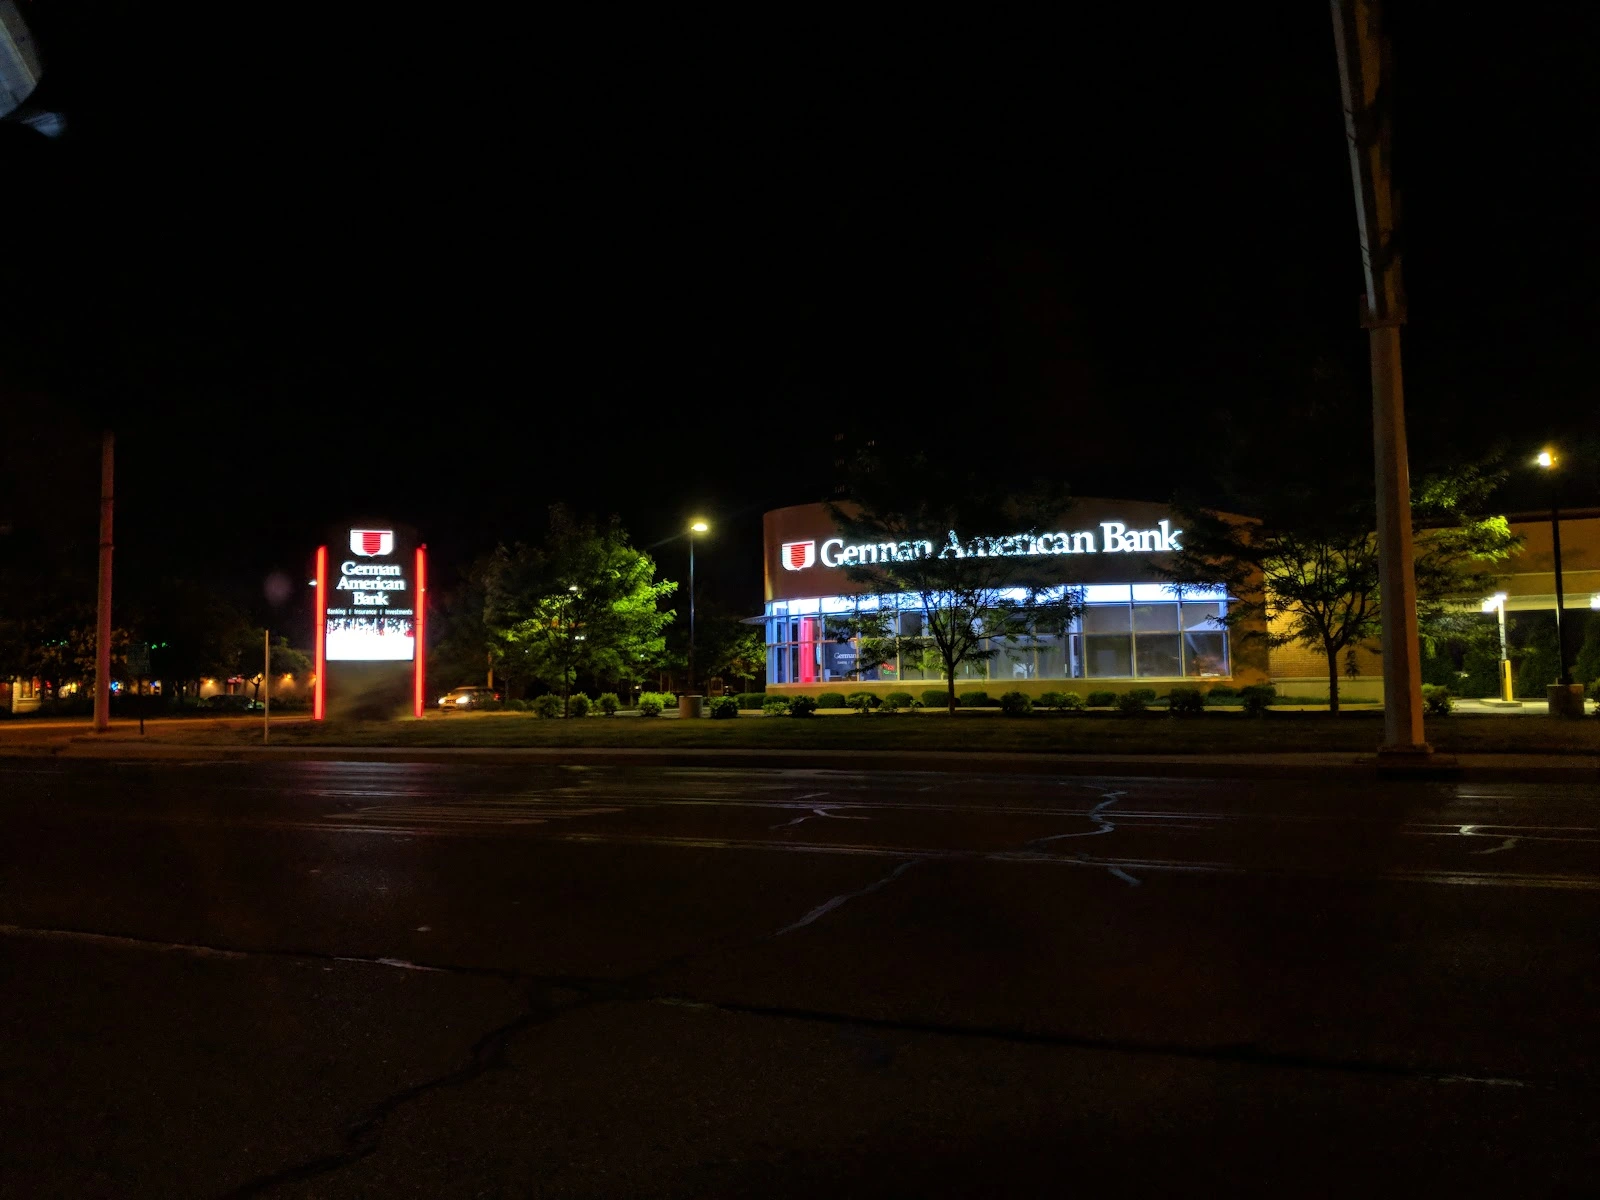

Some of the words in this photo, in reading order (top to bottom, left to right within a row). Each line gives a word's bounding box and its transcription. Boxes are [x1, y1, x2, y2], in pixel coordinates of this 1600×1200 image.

[820, 538, 933, 568] German
[938, 529, 1097, 557] American
[1100, 519, 1184, 553] Bank
[341, 561, 401, 576] German
[336, 576, 406, 591] American
[352, 591, 389, 606] Bank
[327, 608, 346, 616] Banking
[354, 608, 377, 616] Insurance
[385, 608, 413, 616] Investments
